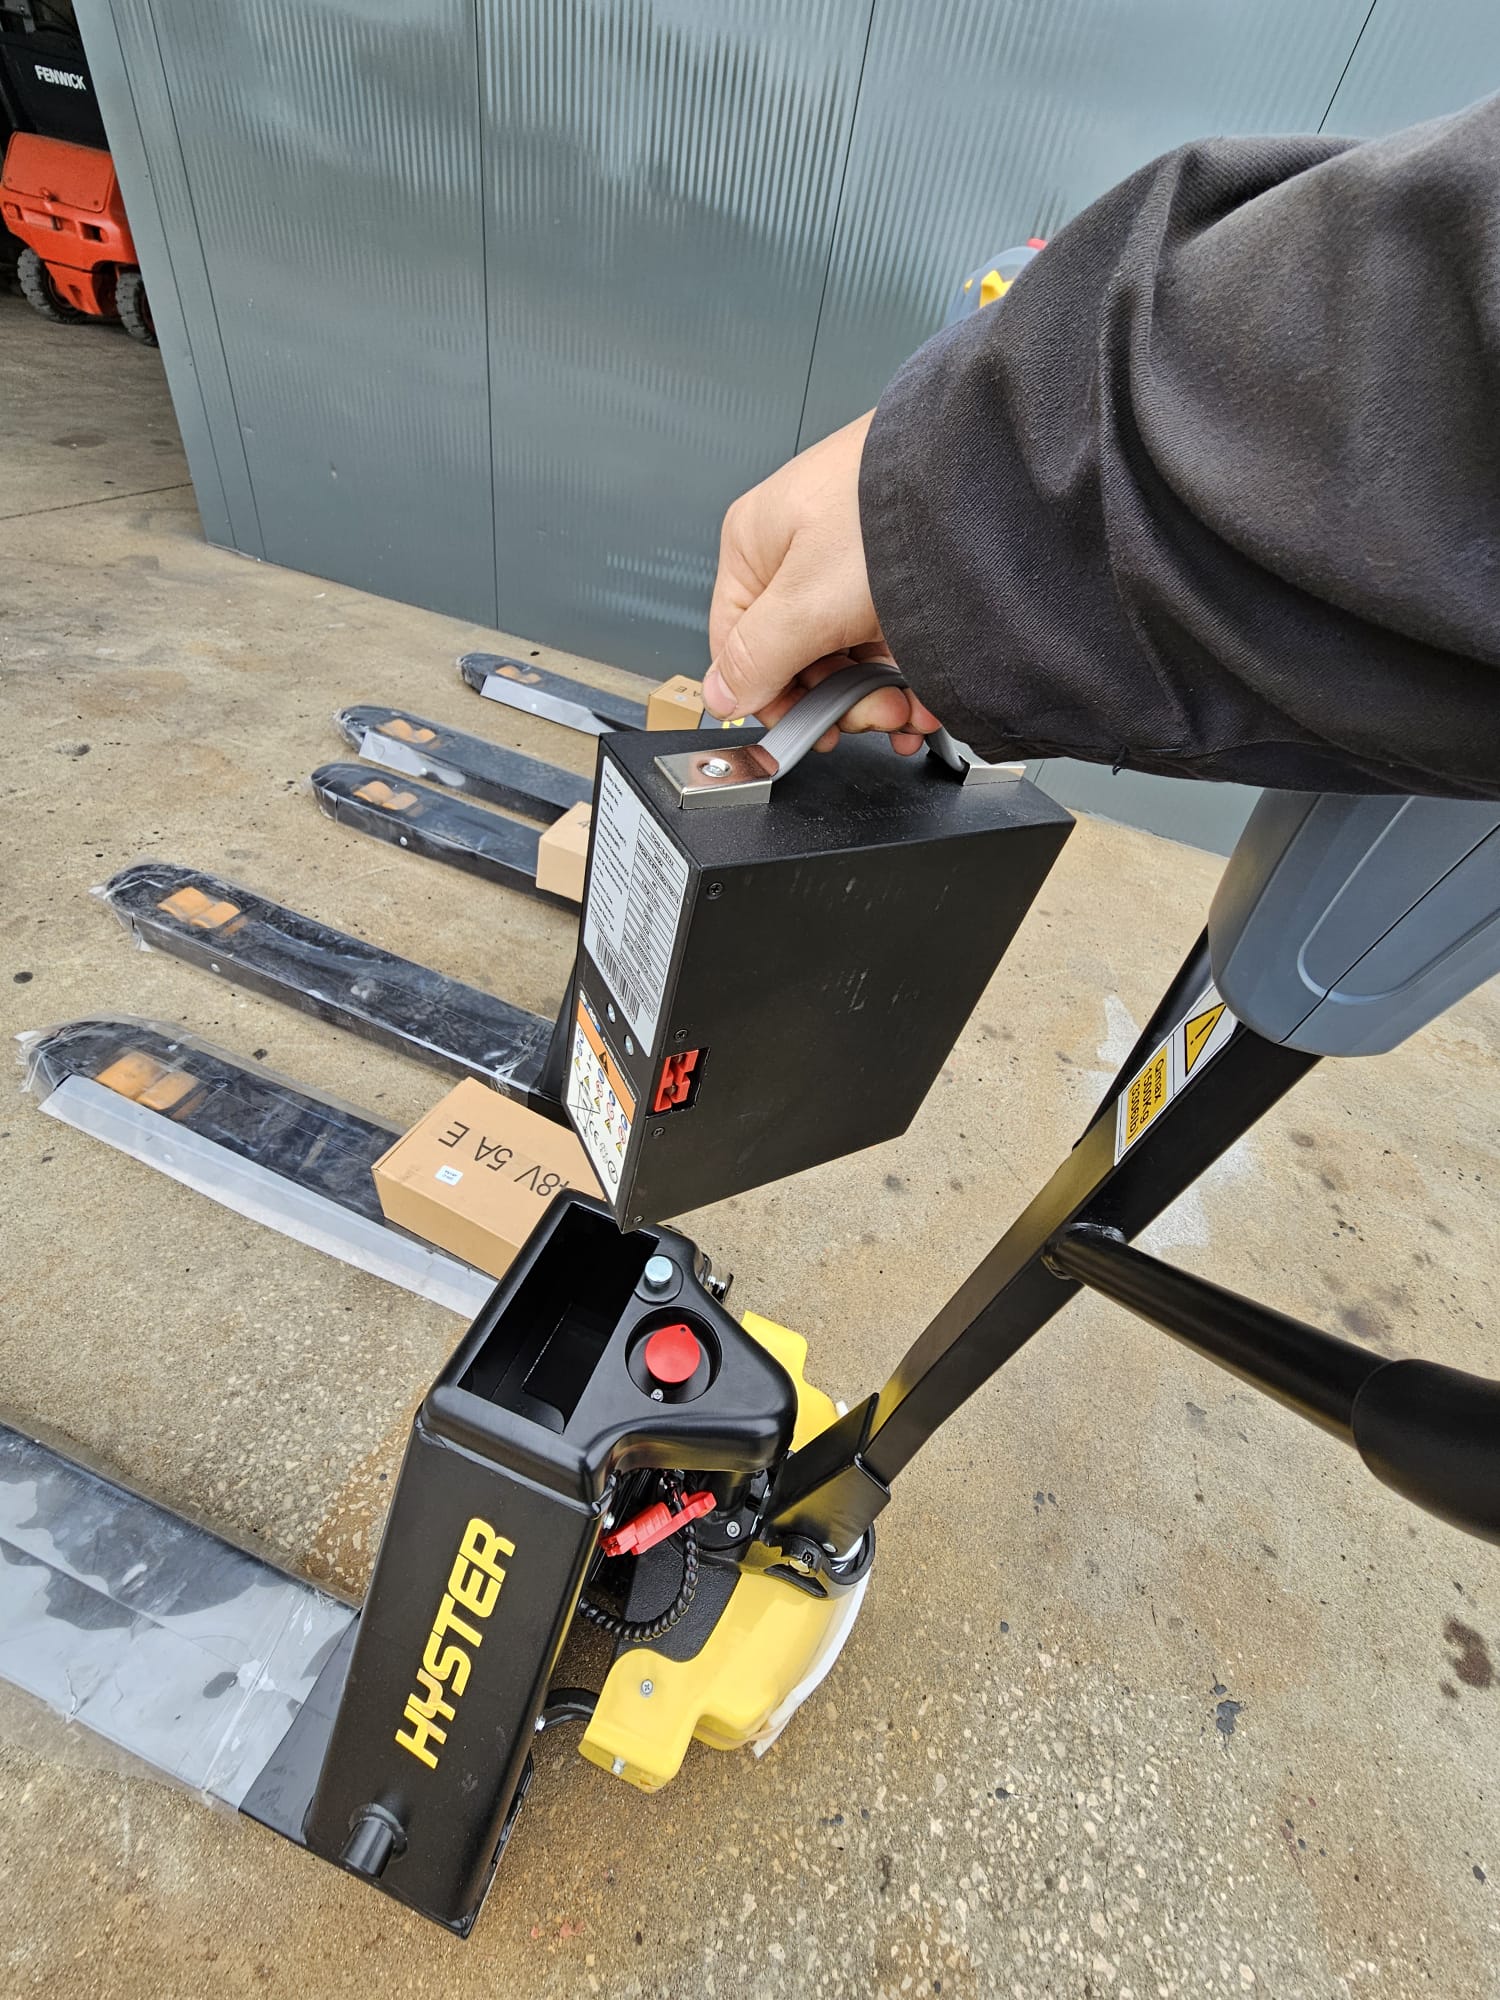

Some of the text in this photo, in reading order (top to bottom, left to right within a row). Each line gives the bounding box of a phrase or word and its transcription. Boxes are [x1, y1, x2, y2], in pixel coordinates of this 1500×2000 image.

[34, 64, 86, 90] FENWICK
[438, 1121, 470, 1148] E
[473, 1136, 513, 1172] 5A
[394, 1517, 517, 1770] HYSTER
